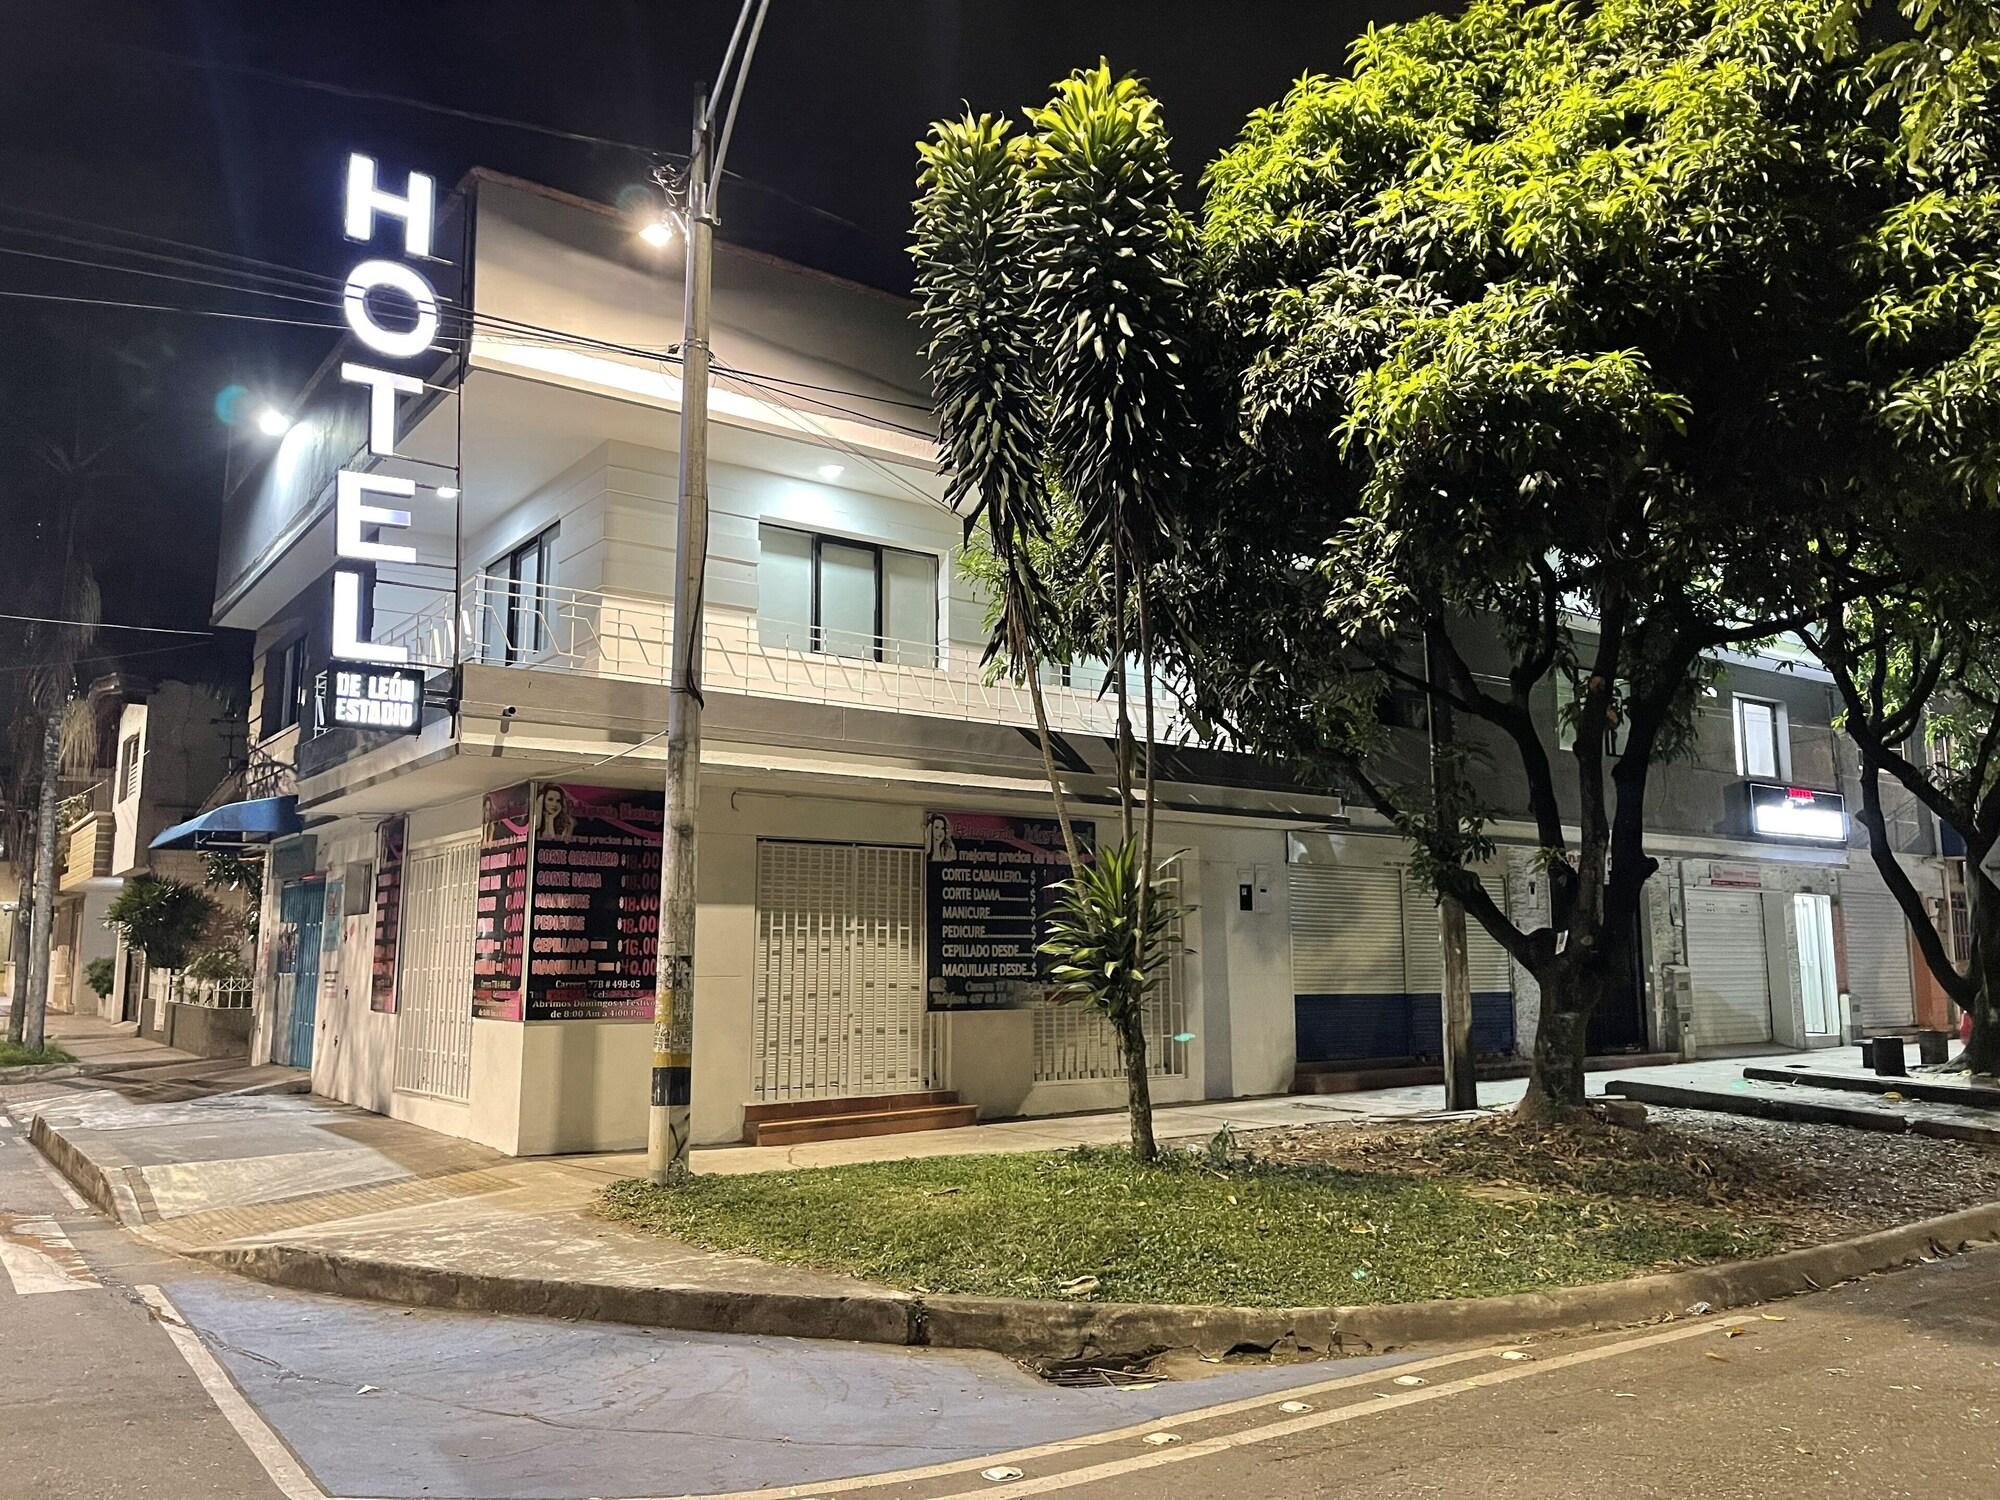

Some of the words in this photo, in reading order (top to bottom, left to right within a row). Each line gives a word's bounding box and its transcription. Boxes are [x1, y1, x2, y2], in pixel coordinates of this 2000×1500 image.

[331, 152, 438, 663] HOTEL
[336, 672, 361, 698] DE
[368, 671, 415, 702] LEÓN
[335, 697, 413, 728] ESTADIO
[538, 849, 567, 864] CORTE
[568, 850, 619, 867] CABALLERO
[536, 871, 570, 887] CORTE
[572, 872, 602, 888] DAMA
[942, 868, 971, 882] CORTE
[972, 869, 1022, 884] CABALLERO
[535, 893, 590, 910] MANICURE
[942, 887, 972, 900] CORTE
[533, 915, 586, 931] PEDICURE
[532, 937, 590, 953] CEPILLADO
[942, 944, 990, 958] CEPILLADO
[531, 959, 597, 976] MAQUILLAJE
[942, 963, 998, 977] MAQUILLAJE
[613, 980, 641, 989] 49B-05
[532, 1000, 572, 1008] Abrimos
[573, 1000, 619, 1010] Domingos
[626, 999, 657, 1008] Festivo
[550, 1010, 562, 1019] de
[563, 1010, 584, 1018] 8:00
[585, 1010, 600, 1018] Am
[609, 1010, 629, 1018] 4:00
